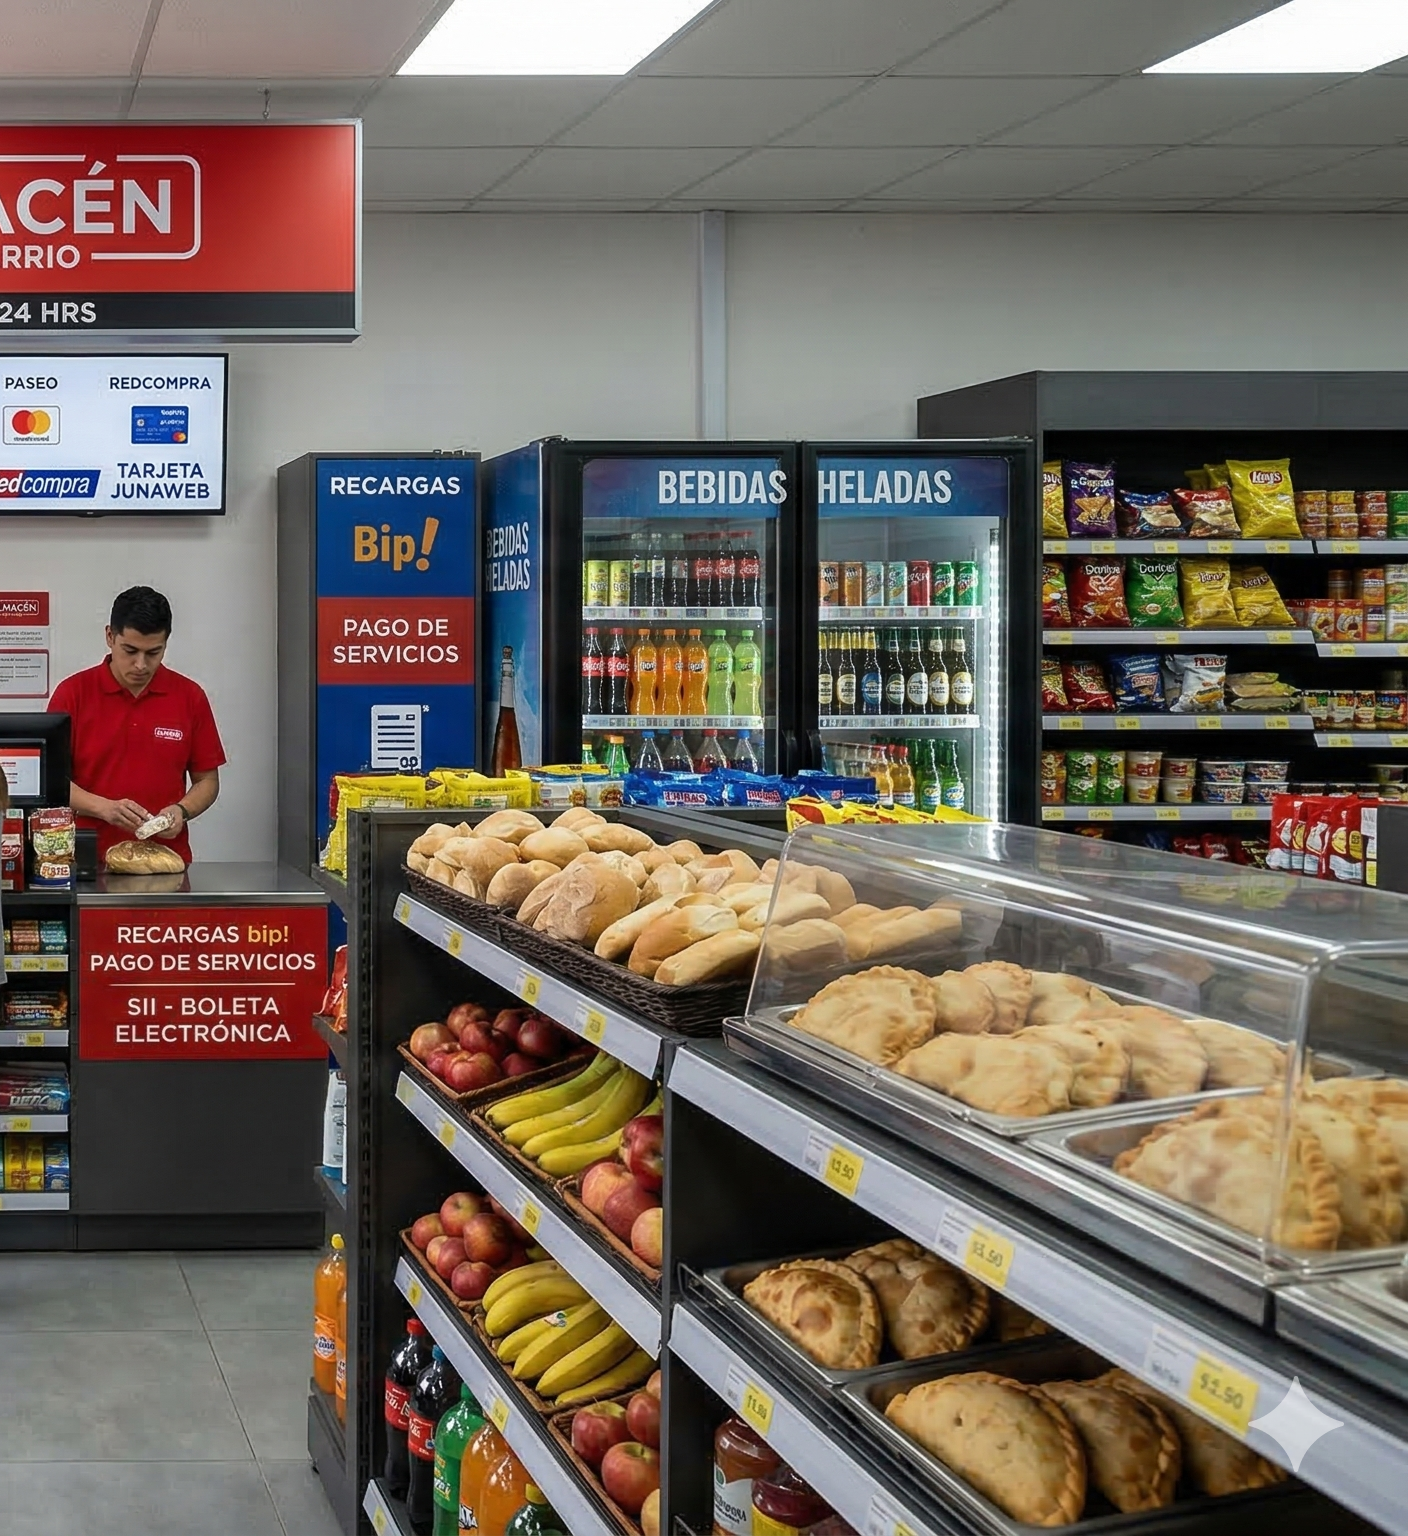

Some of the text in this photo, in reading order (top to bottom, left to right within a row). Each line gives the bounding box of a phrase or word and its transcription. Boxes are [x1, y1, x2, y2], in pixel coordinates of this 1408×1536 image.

[40, 302, 98, 324] HRS
[5, 376, 59, 390] PASEO
[109, 377, 212, 390] REDCOMPRA
[117, 462, 205, 479] TARJETA
[110, 482, 211, 499] JUNAWEB
[330, 476, 461, 495] RECARGAS
[658, 470, 788, 504] BEBIDAS
[817, 470, 953, 504] HELADAS
[354, 516, 440, 572] Bip!
[486, 521, 530, 559] BEBIDAS
[485, 557, 531, 593] HELADAS
[344, 618, 450, 637] PAGO DE
[333, 645, 460, 664] SERVICIOS
[117, 925, 289, 947] RECARGAS bip!
[90, 953, 316, 972] PAGO DE SERVICIOS
[127, 997, 156, 1016] SII
[181, 997, 280, 1016] BOLETA
[115, 1019, 292, 1043] ELECTRÓNICA
